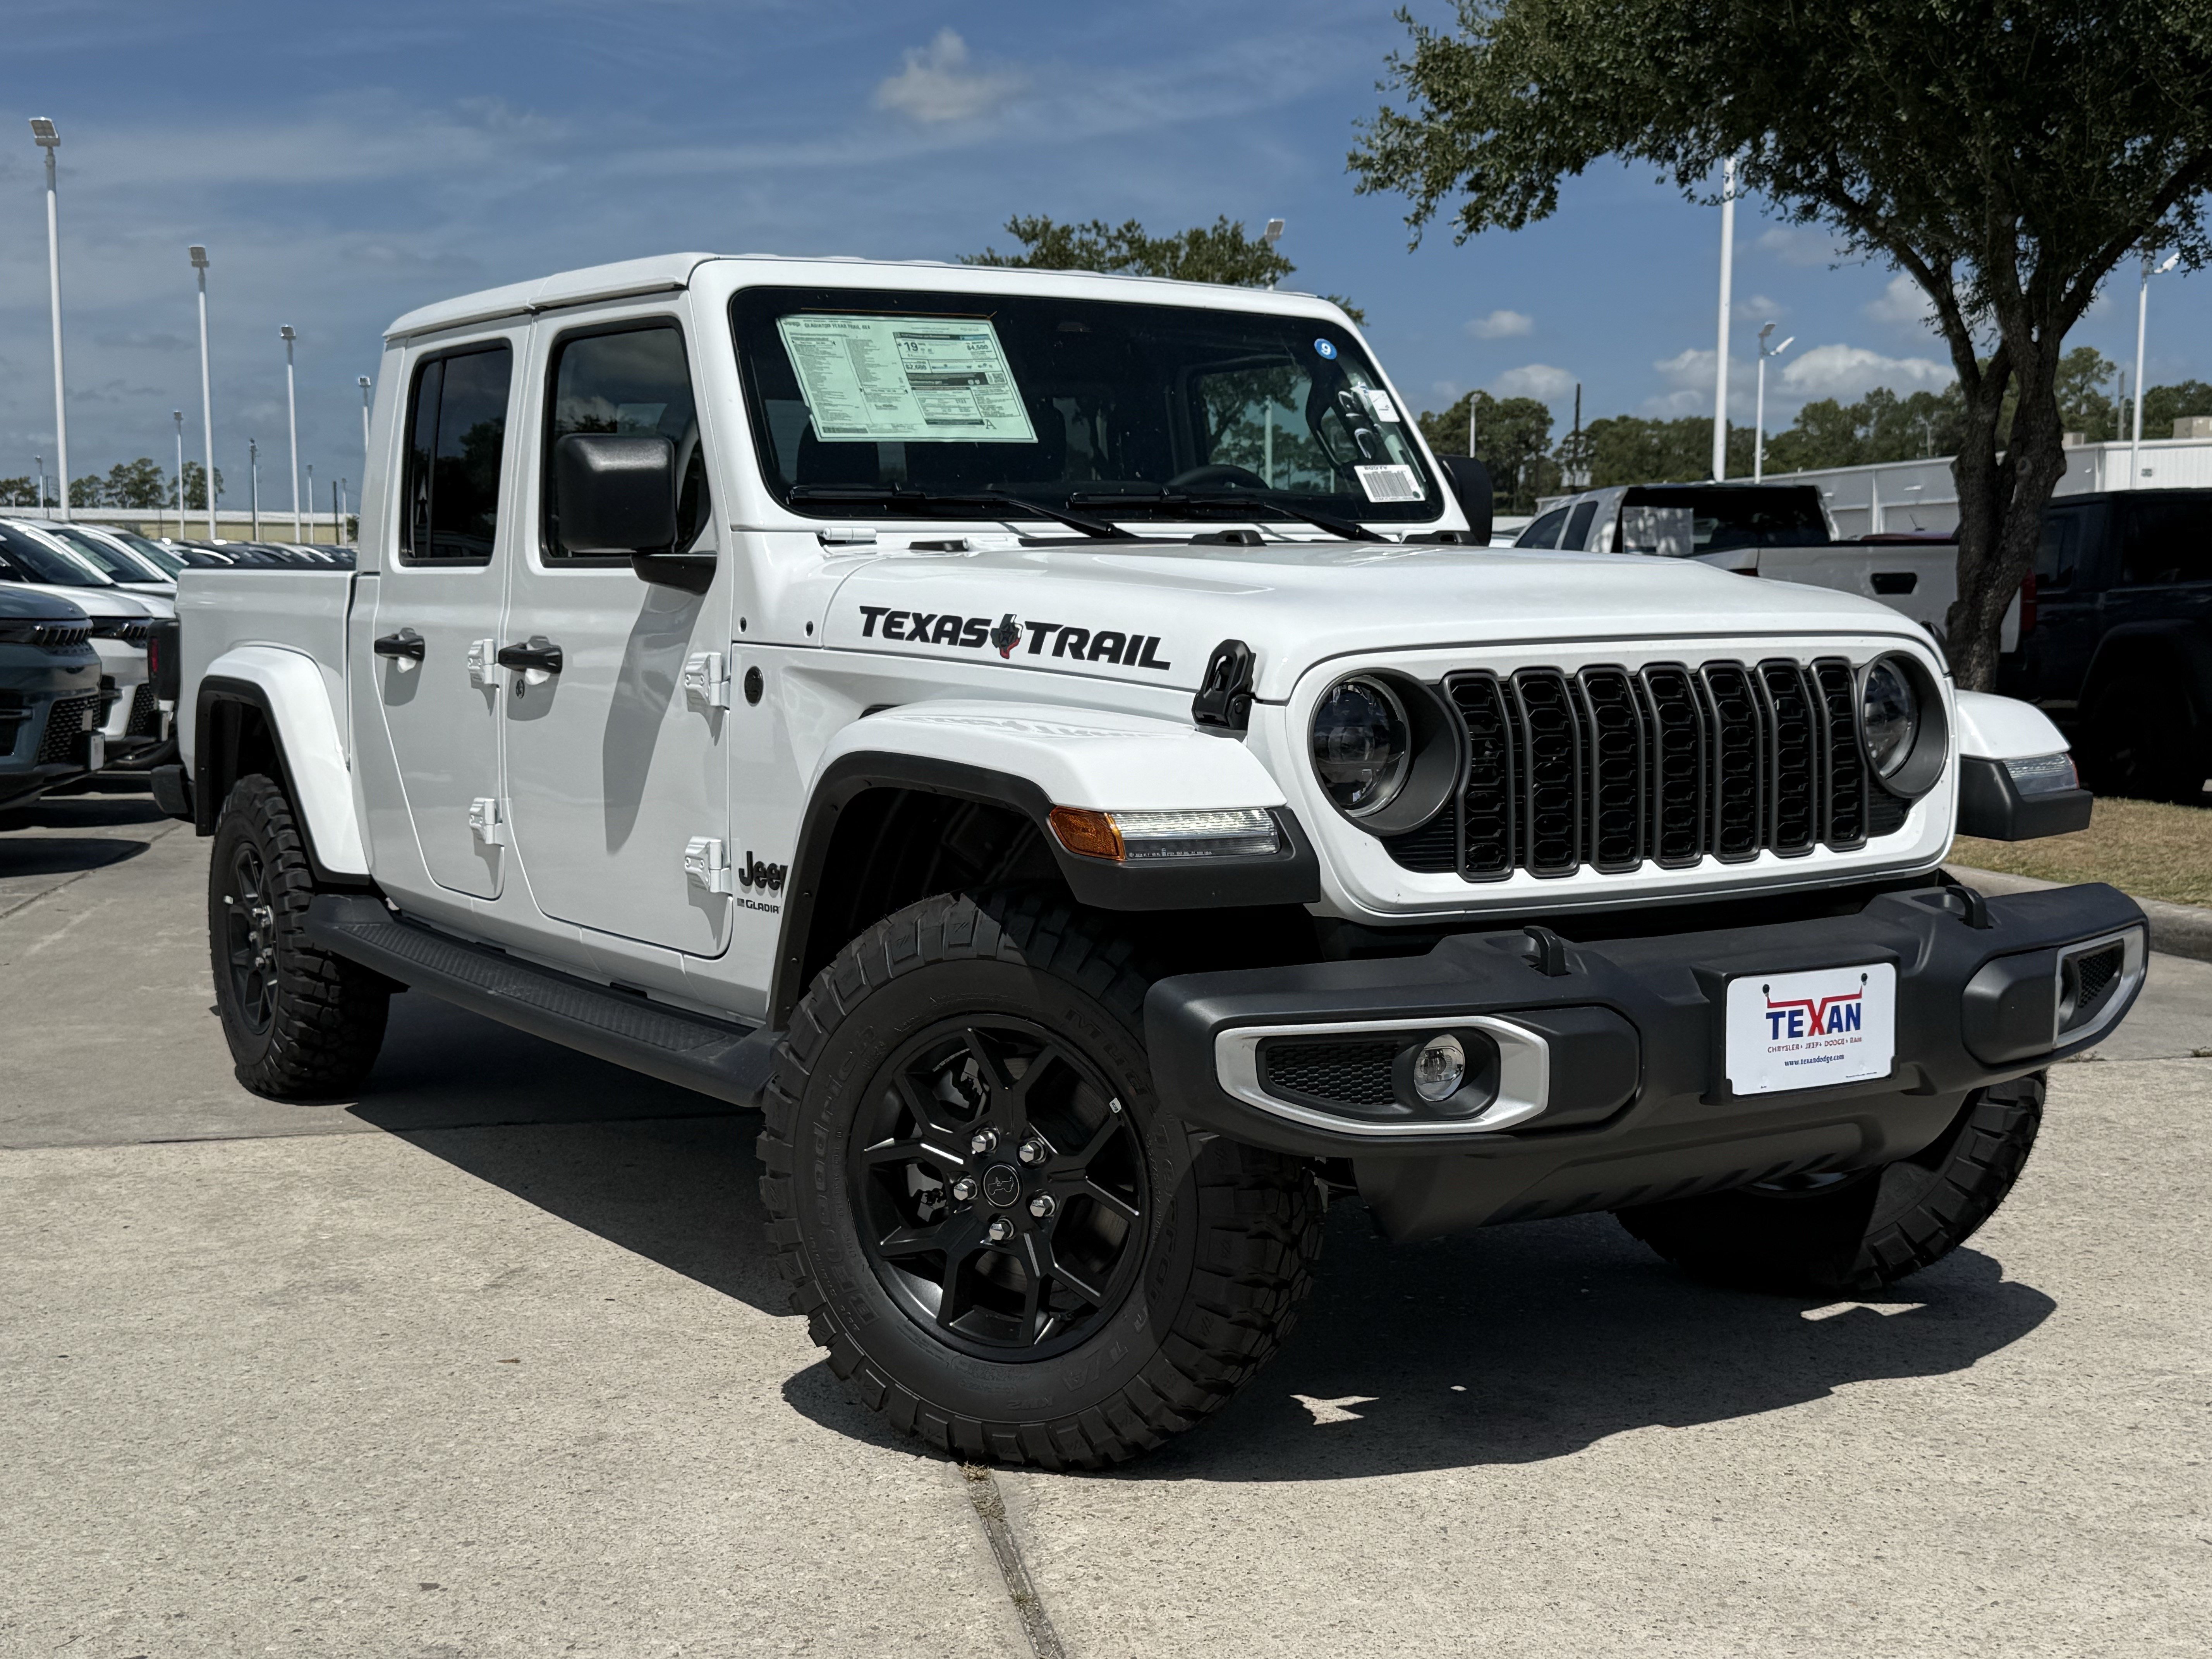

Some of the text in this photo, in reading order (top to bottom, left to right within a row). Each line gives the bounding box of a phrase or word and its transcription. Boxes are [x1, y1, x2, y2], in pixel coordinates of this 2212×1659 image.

[904, 342, 919, 352] 19
[1321, 342, 1331, 355] 9
[984, 419, 998, 430] A
[859, 606, 1171, 671] TEXAS TRAIL
[746, 899, 781, 914] GLADIA
[1766, 997, 1861, 1041] TEXAN
[1767, 1044, 1800, 1054] CHRYSLER
[1824, 1038, 1845, 1047] DODGE
[1784, 1054, 1845, 1067] www.texandodge.com
